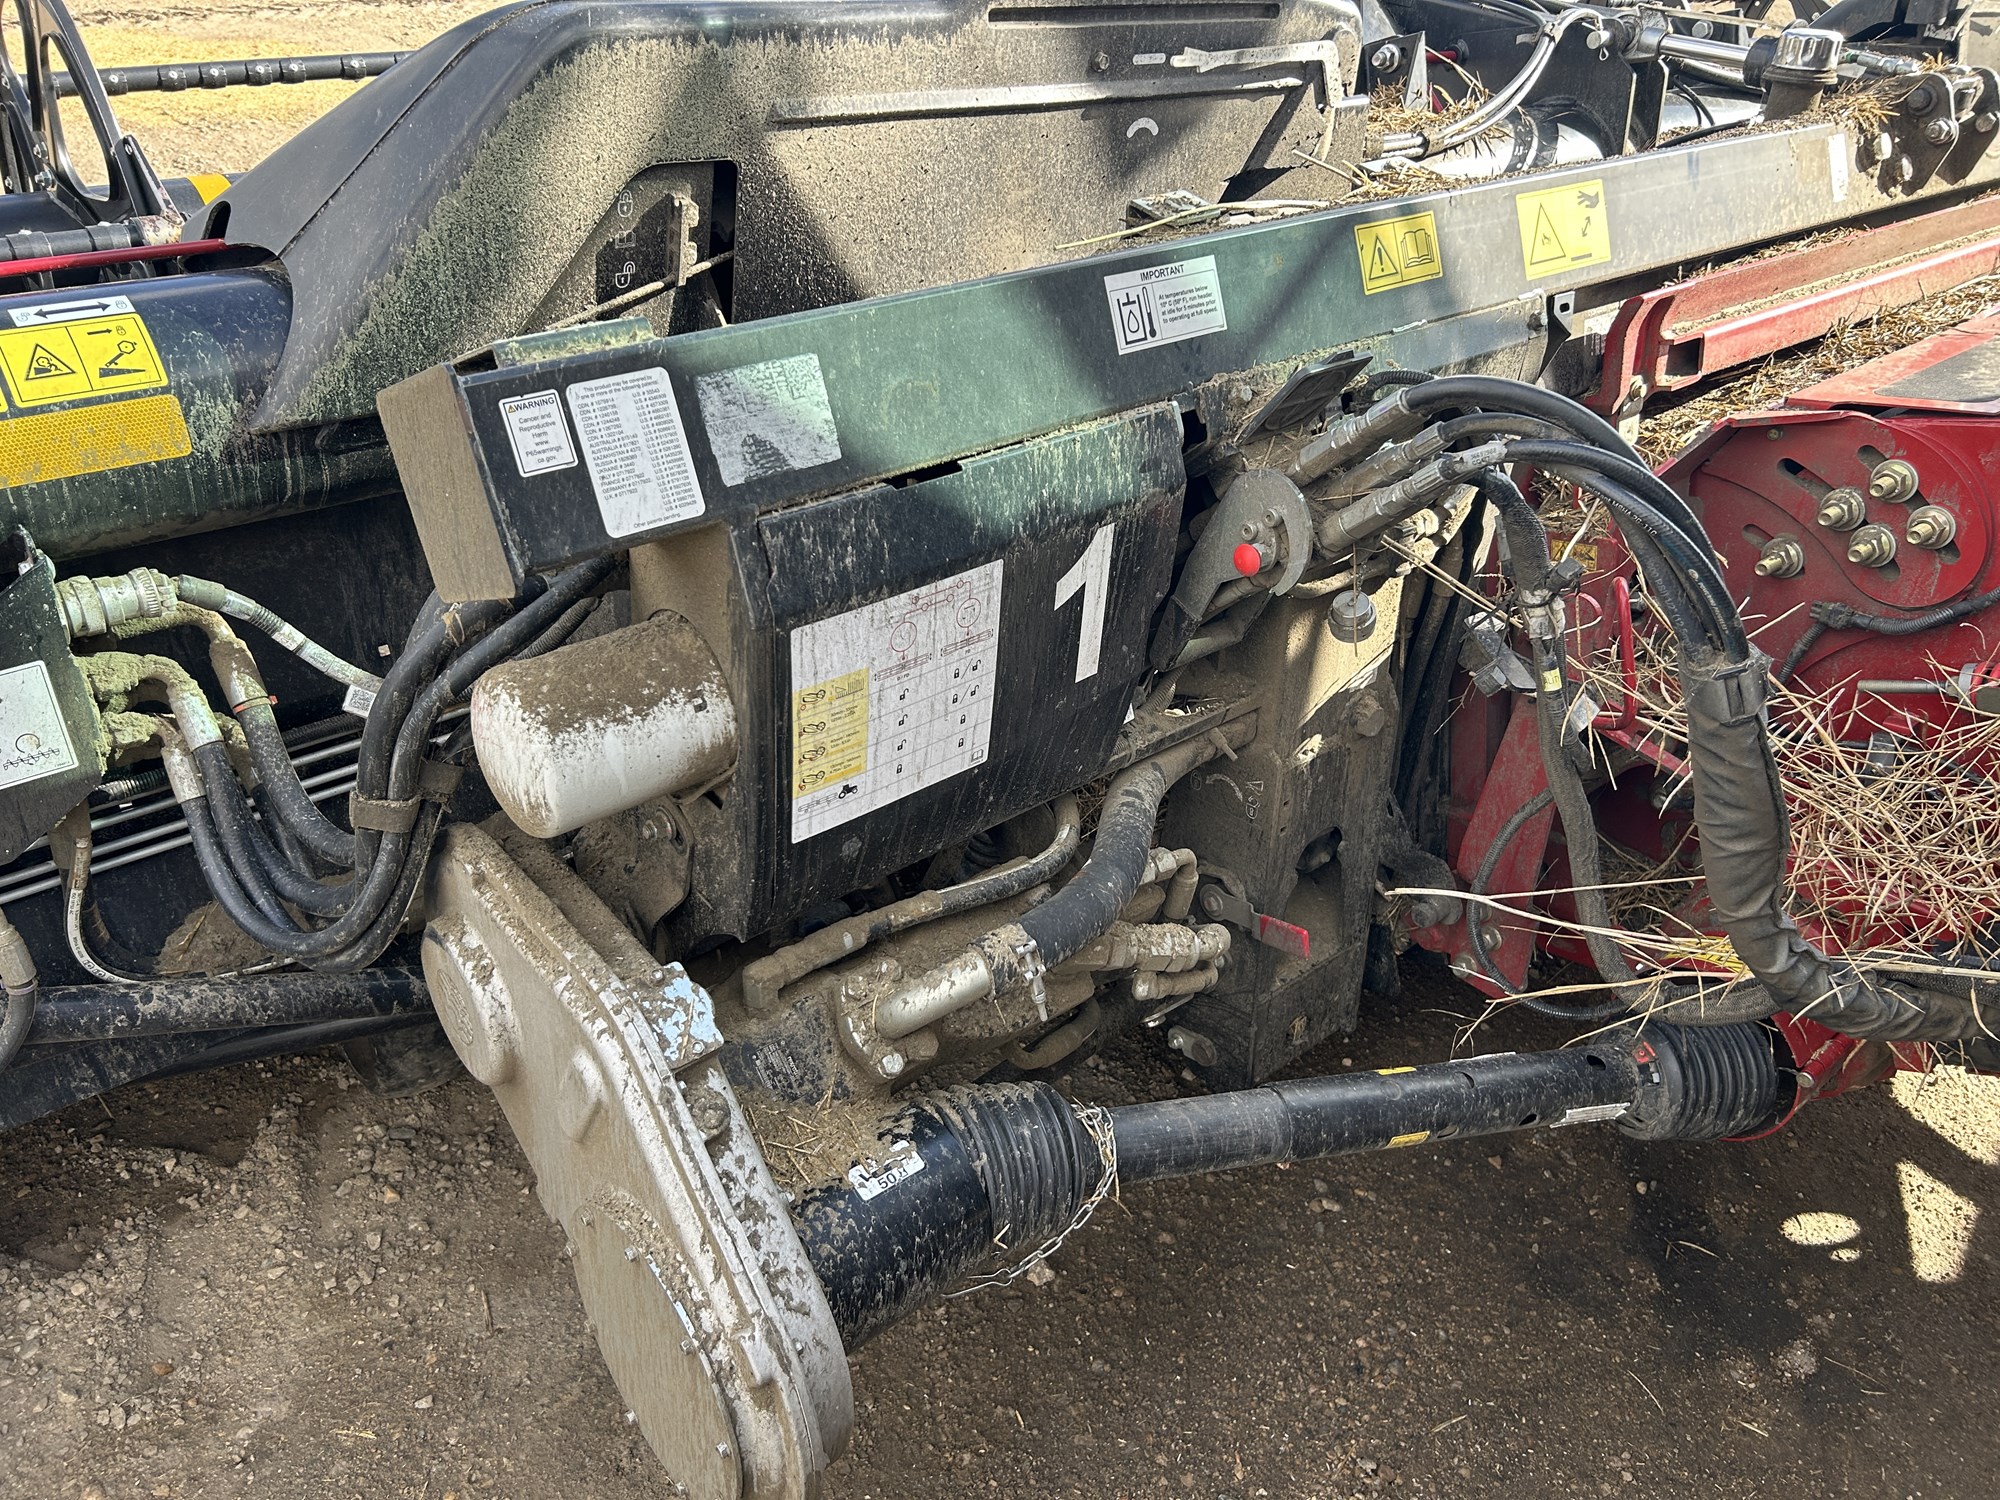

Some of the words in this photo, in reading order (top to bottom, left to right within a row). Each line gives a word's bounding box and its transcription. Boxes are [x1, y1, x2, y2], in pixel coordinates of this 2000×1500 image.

[1140, 264, 1184, 281] IMPORTANT
[1164, 288, 1194, 299] temperatures
[1205, 299, 1215, 307] prior
[1168, 313, 1190, 322] operating
[1203, 306, 1217, 314] speed.
[594, 383, 611, 391] product
[628, 375, 646, 383] covered
[621, 383, 641, 391] following
[513, 397, 554, 411] WARNING
[518, 415, 539, 424] Cancer
[540, 411, 551, 419] and
[518, 420, 556, 432] Reproductive
[589, 438, 617, 448] AUSTRALIA
[591, 444, 618, 454] AUSTRALIA
[592, 450, 625, 461] KAZAKHSTAN
[594, 459, 613, 467] RUSSIA
[596, 464, 618, 474] UKRAINE
[600, 478, 621, 487] FRANCE
[601, 483, 626, 494] GERMANY
[1054, 523, 1115, 683] 1
[877, 1172, 897, 1189] 50
